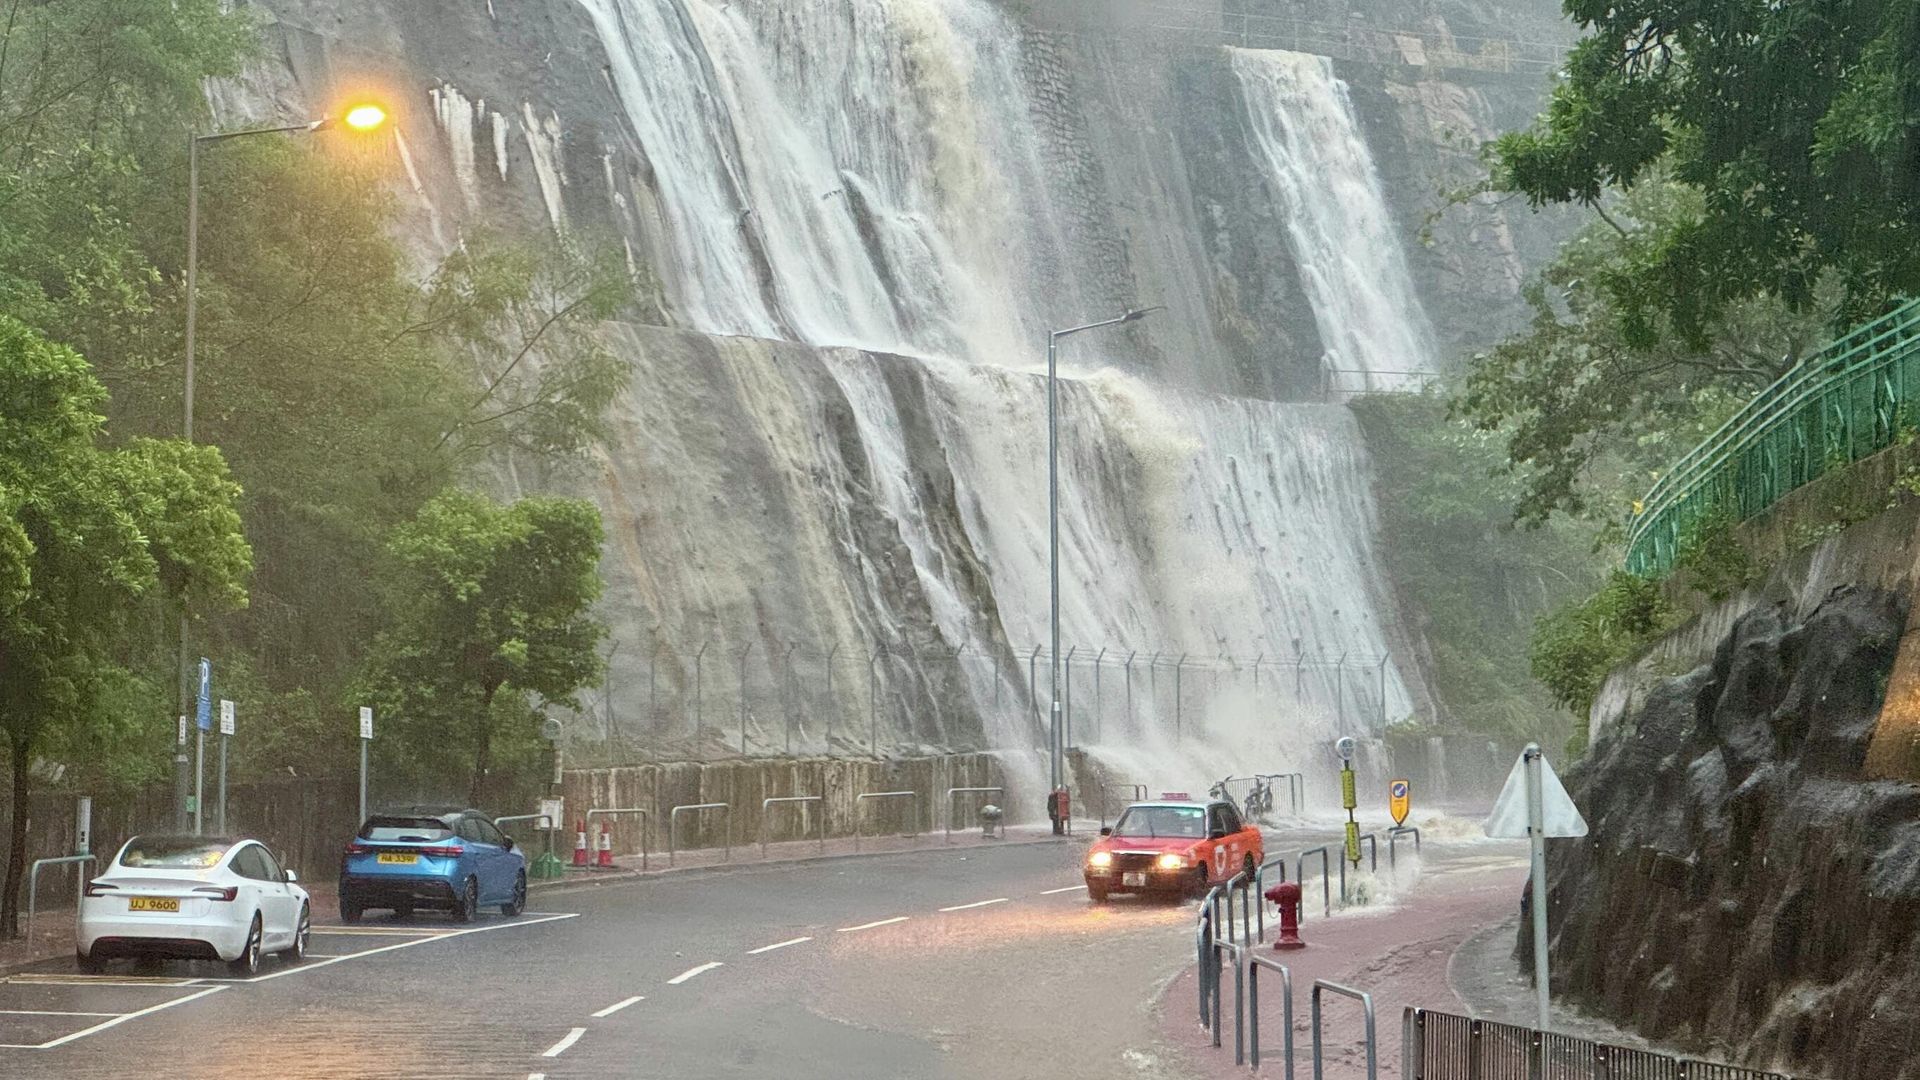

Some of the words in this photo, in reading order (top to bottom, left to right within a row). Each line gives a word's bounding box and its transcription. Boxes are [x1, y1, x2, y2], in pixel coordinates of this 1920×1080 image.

[202, 661, 208, 695] P
[131, 900, 145, 909] UJ
[149, 900, 177, 910] 9600
